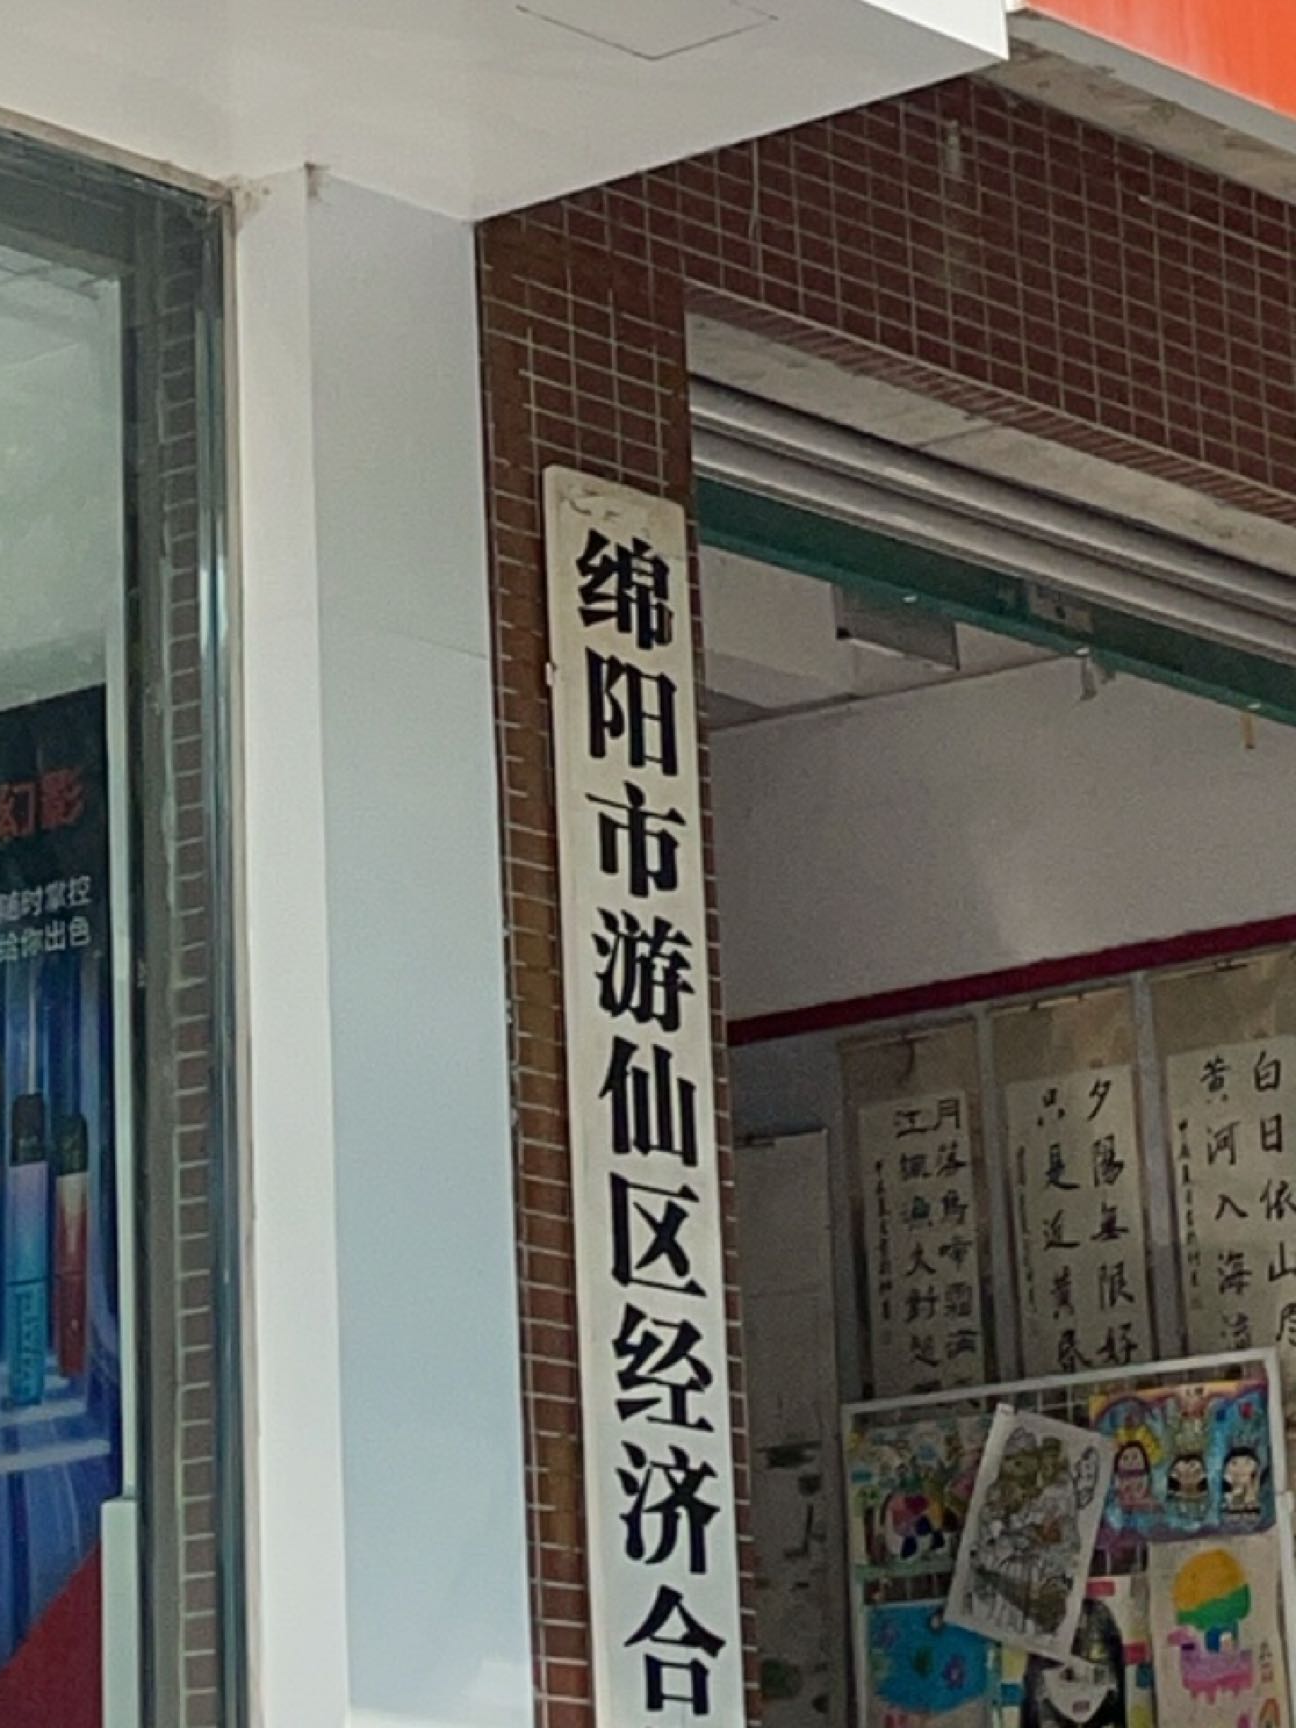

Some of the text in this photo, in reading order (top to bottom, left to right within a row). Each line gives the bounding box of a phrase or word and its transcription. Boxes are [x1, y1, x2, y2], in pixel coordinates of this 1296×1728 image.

[576, 528, 726, 1715] 绵阳市游仙区经济合
